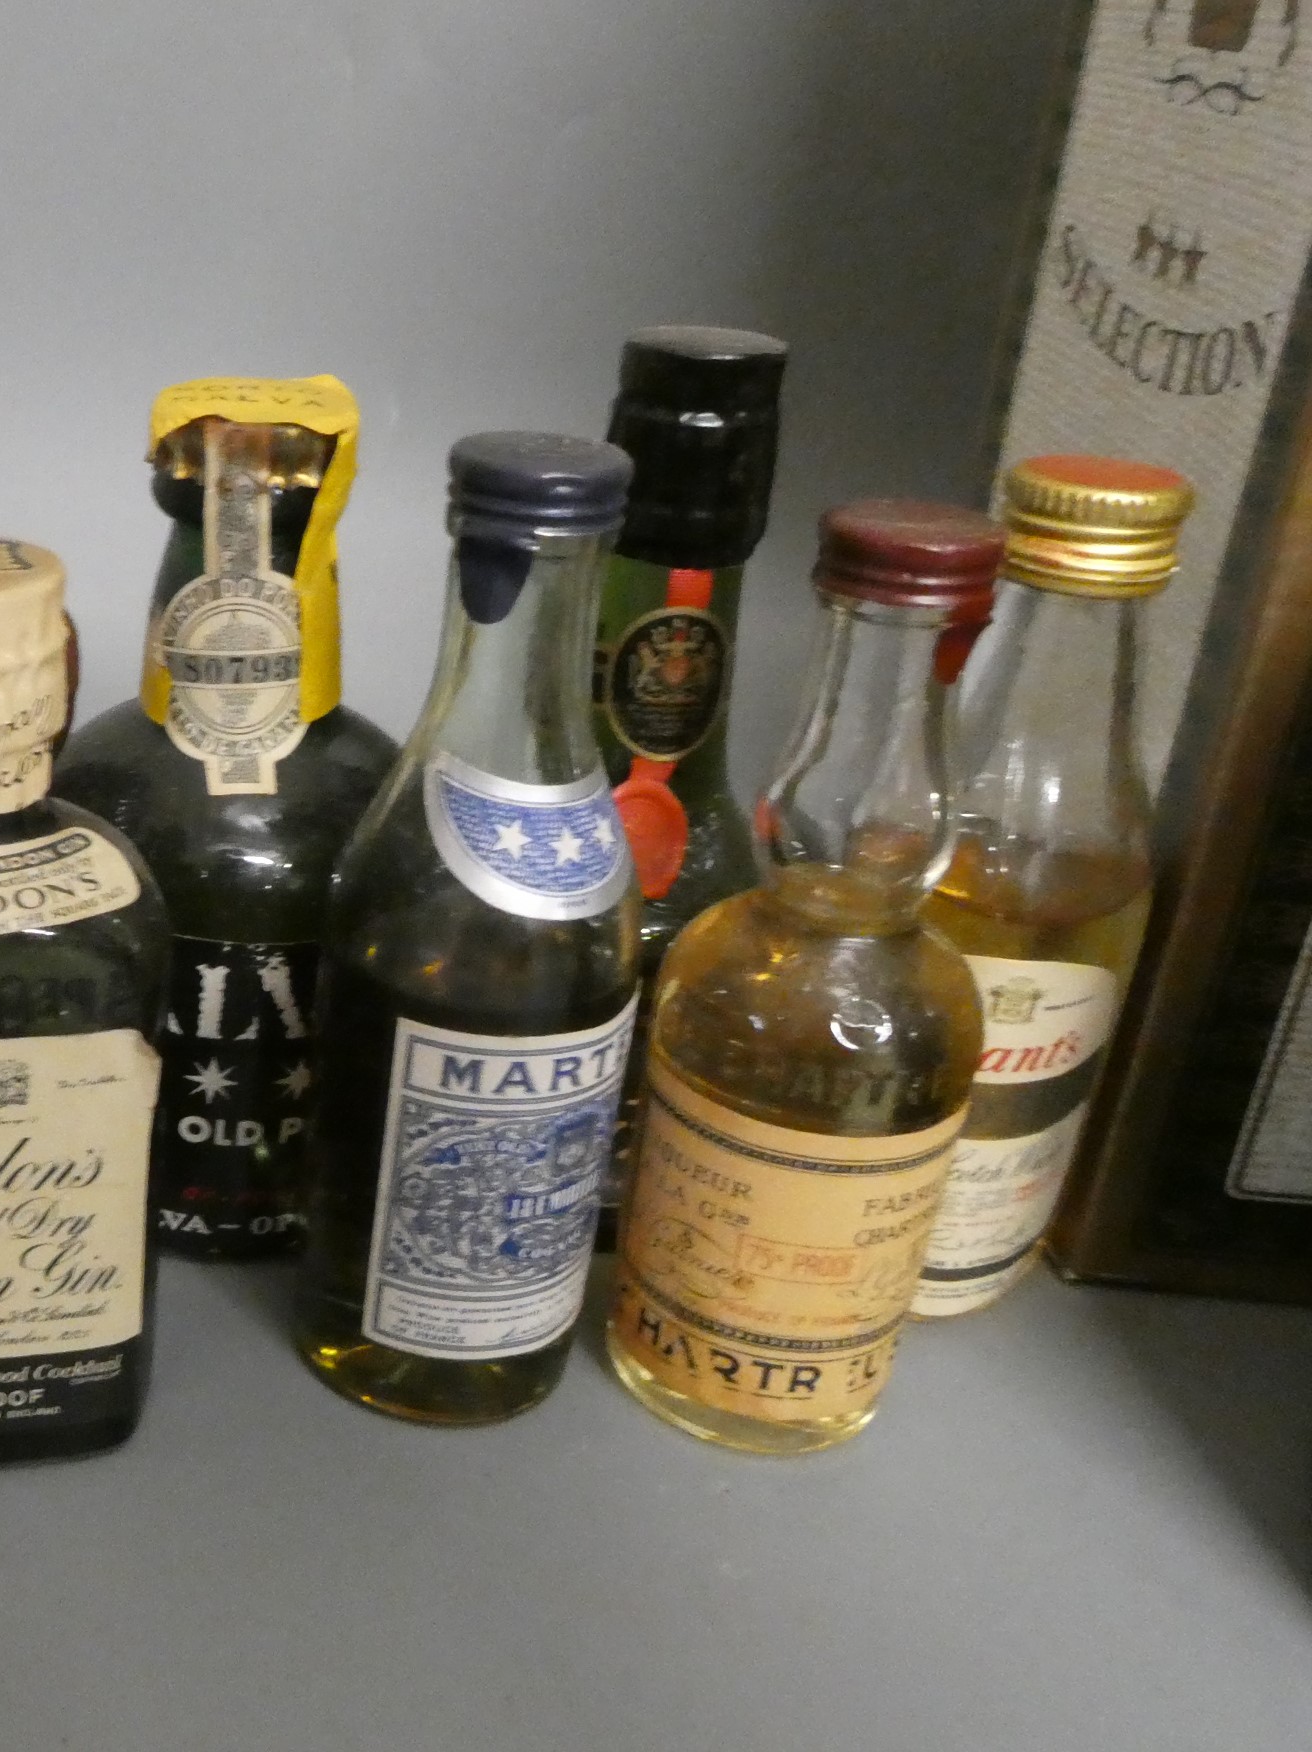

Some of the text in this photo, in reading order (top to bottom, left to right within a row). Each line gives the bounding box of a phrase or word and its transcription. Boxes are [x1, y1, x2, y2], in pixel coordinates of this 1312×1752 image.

[1058, 222, 1280, 396] SELECTION
[177, 1115, 265, 1148] OLD
[6, 1197, 96, 1246] Dry
